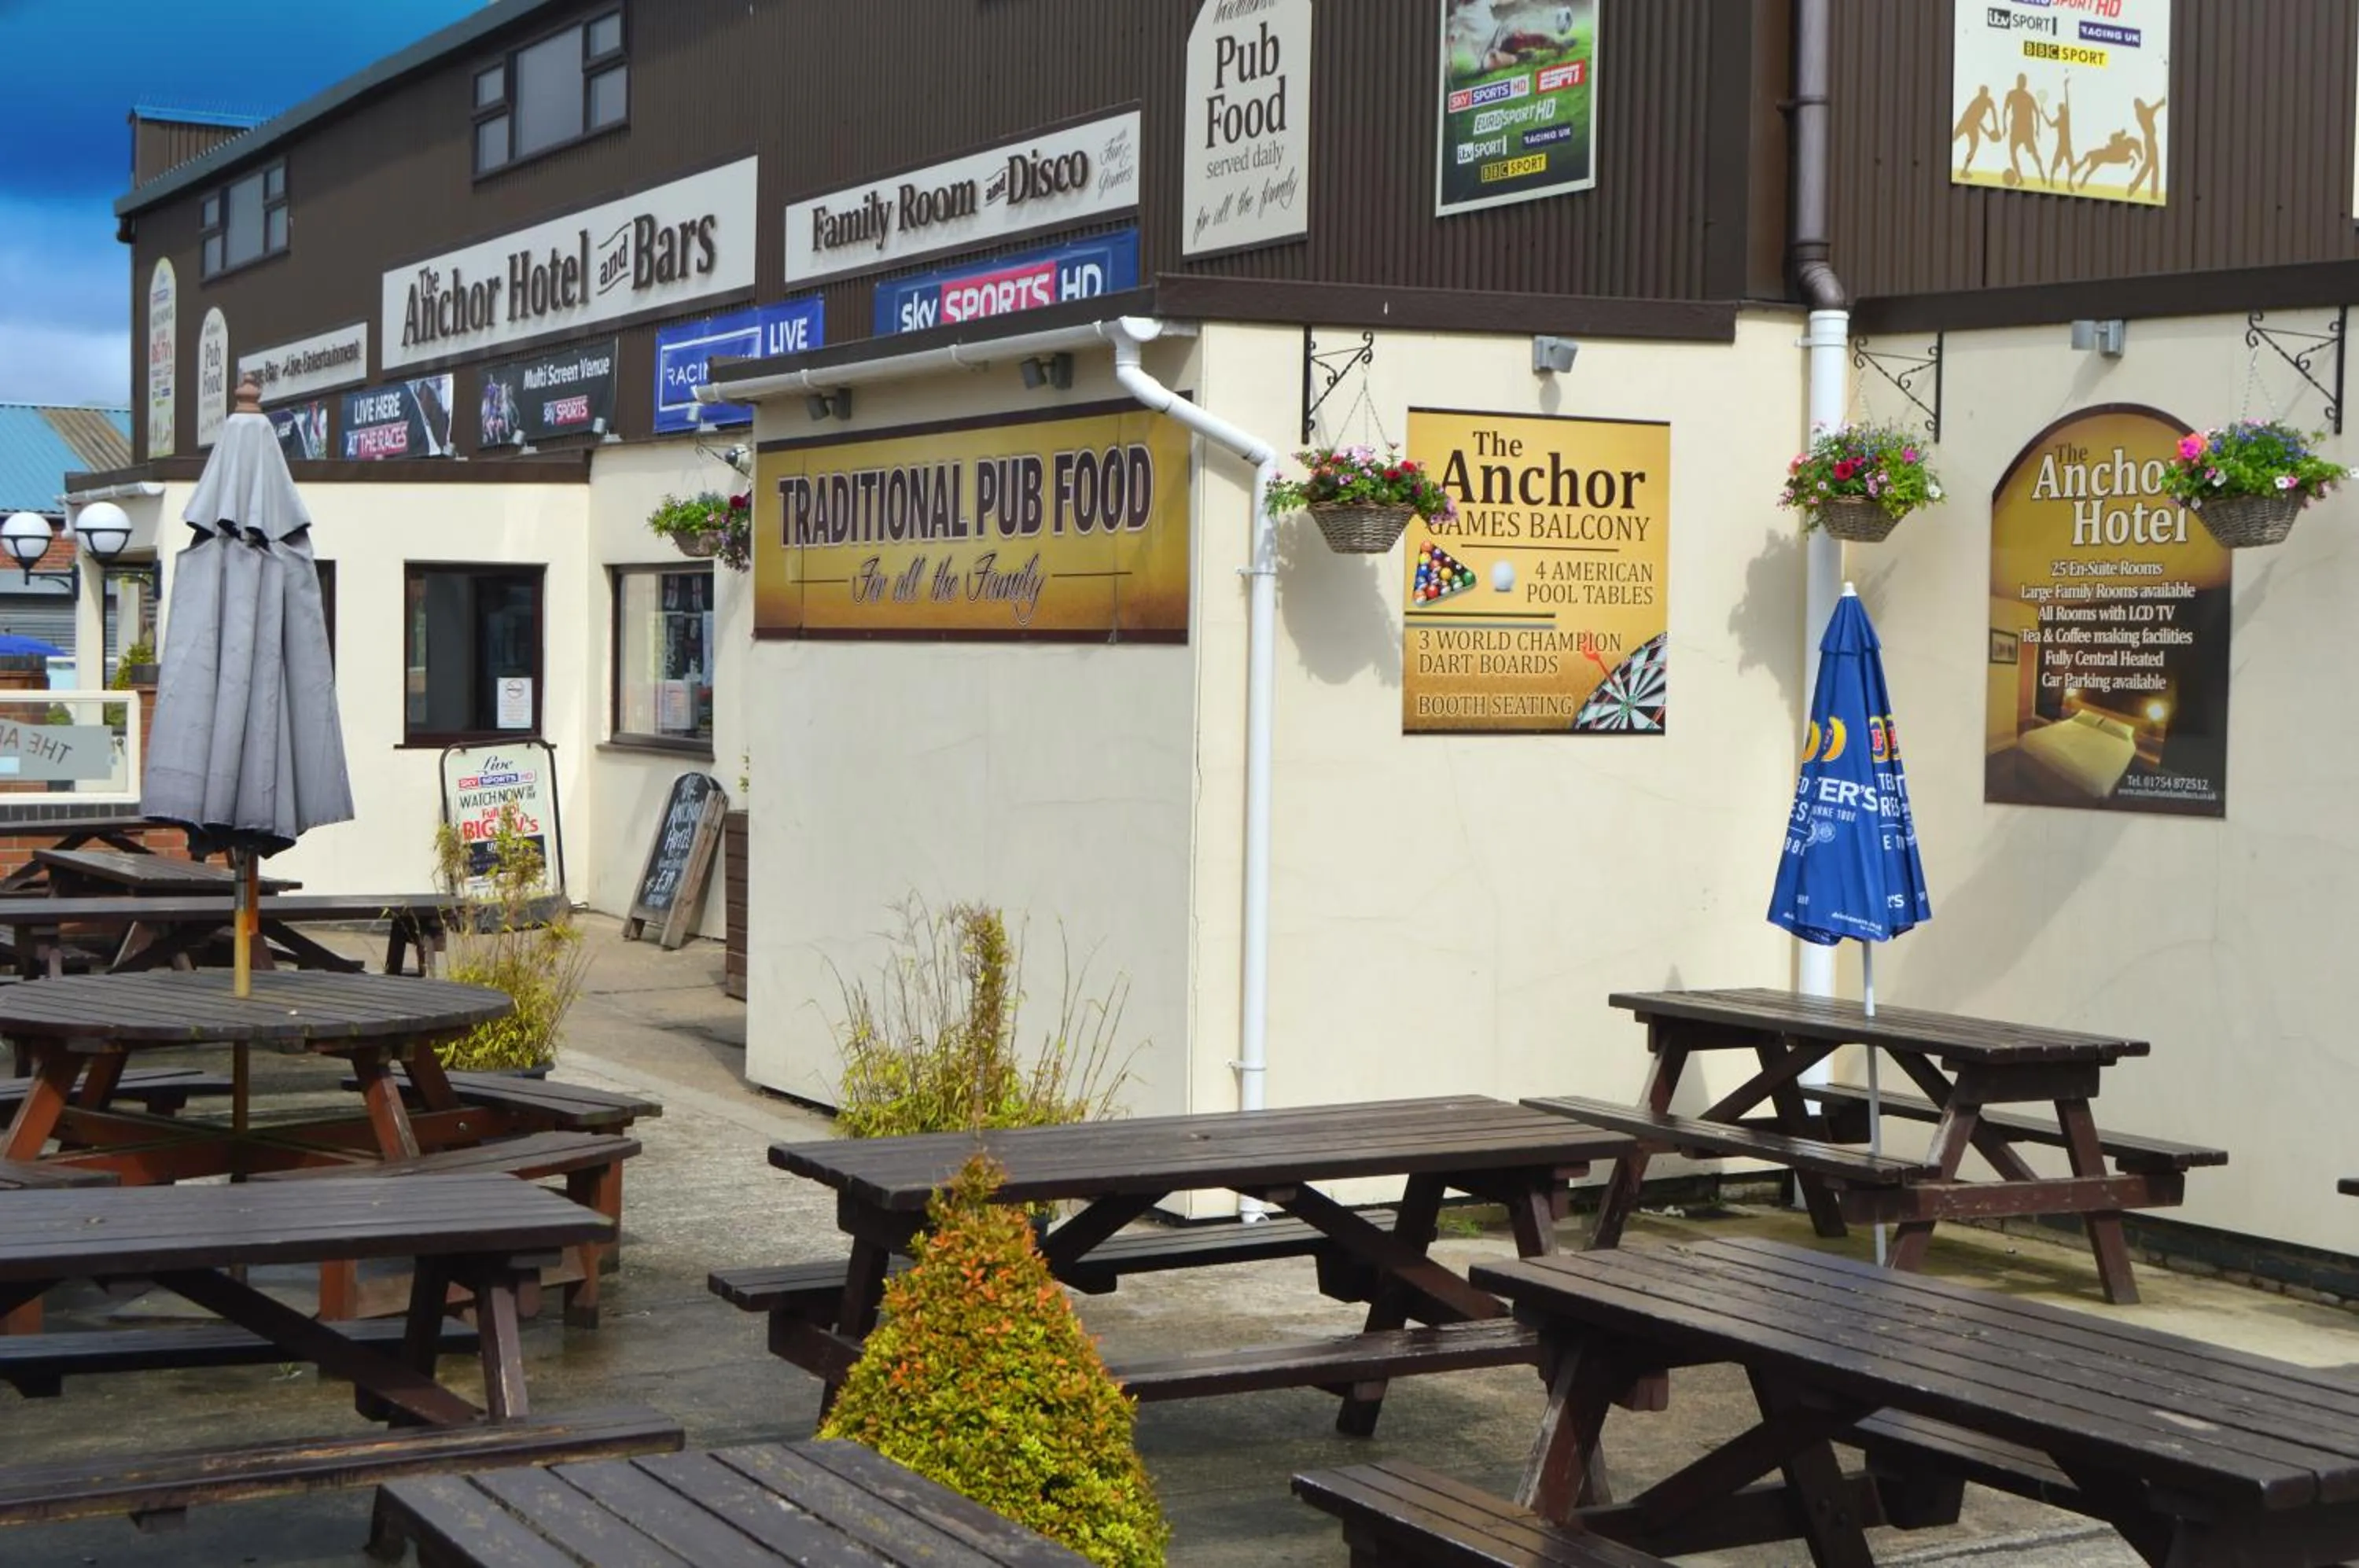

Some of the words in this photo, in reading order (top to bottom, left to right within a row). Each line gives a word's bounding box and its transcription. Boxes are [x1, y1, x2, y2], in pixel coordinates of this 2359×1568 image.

[2012, 14, 2050, 31] SPORT
[2125, 34, 2140, 43] UK
[1214, 20, 1280, 90] Pub
[2024, 41, 2059, 60] BBC
[2062, 49, 2105, 64] SPORT
[1539, 64, 1580, 90] ESPN
[1452, 94, 1470, 111] SKY
[1474, 83, 1509, 104] SPORTS
[1513, 79, 1527, 93] HD
[1205, 75, 1286, 149] Food
[1536, 98, 1557, 123] HD
[1206, 145, 1249, 179] served
[1253, 140, 1284, 170] daily
[1474, 139, 1502, 158] SPORT
[1483, 161, 1508, 181] BBC
[1511, 156, 1544, 174] SPORT
[812, 186, 893, 252] Family
[897, 179, 977, 232] Room
[985, 171, 1007, 202] and
[1007, 148, 1089, 206] Disco
[1213, 193, 1233, 226] all
[1237, 186, 1253, 217] the
[1258, 166, 1298, 219] family
[402, 268, 501, 348] Anchor
[507, 229, 590, 322] Hotel
[599, 234, 629, 287] and
[632, 213, 716, 291] Bars
[418, 266, 440, 296] The
[901, 293, 939, 333] sky
[945, 272, 1051, 324] SPORTS
[1062, 263, 1102, 300] HD
[770, 318, 808, 354] LIVE
[203, 365, 223, 397] Food
[523, 364, 547, 391] Multi
[548, 363, 579, 386] Screen
[580, 356, 610, 379] Venue
[667, 361, 709, 387] RACI
[355, 396, 375, 425] LIVE
[376, 392, 401, 420] HERE
[555, 399, 588, 424] SPORTS
[347, 432, 359, 456] AT
[1473, 430, 1523, 458] The
[2055, 443, 2089, 463] The
[1442, 449, 1646, 510] Anchor
[778, 458, 969, 548] TRADITIONAL
[974, 452, 1044, 539] PUB
[1052, 442, 1153, 537] FOOD
[1530, 513, 1651, 542] BALCONY
[2071, 499, 2188, 546] Hotel
[1534, 561, 1548, 580] 4
[1551, 561, 1653, 582] AMERICAN
[2051, 561, 2066, 576] 25
[2069, 561, 2118, 576] En-Suite
[2120, 561, 2163, 576] Rooms
[852, 553, 887, 605] For
[893, 554, 926, 603] all
[930, 554, 959, 602] the
[965, 551, 1047, 625] Family
[1526, 584, 1580, 604] POOL
[1583, 585, 1653, 605] TABLES
[2022, 584, 2053, 602] Large
[2055, 583, 2094, 602] Family
[2096, 583, 2138, 598] Rooms
[2140, 582, 2195, 598] available
[2038, 606, 2053, 620] All
[2056, 606, 2097, 621] Rooms
[2099, 605, 2126, 621] with
[2129, 605, 2154, 621] LCD
[2156, 605, 2175, 621] TV
[1419, 631, 1430, 651] 3
[1437, 631, 1511, 651] WORLD
[1517, 631, 1622, 652] CHAMPION
[2022, 628, 2041, 642] Tea
[2043, 628, 2053, 642] &
[2055, 628, 2092, 643] Coffee
[2094, 628, 2140, 647] making
[2141, 628, 2193, 644] facilities
[1419, 653, 1474, 674] DART
[1480, 654, 1559, 675] BOARDS
[2045, 650, 2074, 668] Fully
[2075, 650, 2118, 666] Central
[2120, 651, 2164, 667] Heated
[2042, 673, 2062, 687] Car
[2064, 673, 2111, 692] Parking
[2112, 674, 2166, 690] available
[1419, 695, 1485, 715] BOOTH
[1492, 695, 1573, 716] SEATING
[459, 792, 496, 809] WATCH
[498, 786, 525, 802] NOW
[462, 819, 495, 841] BIG
